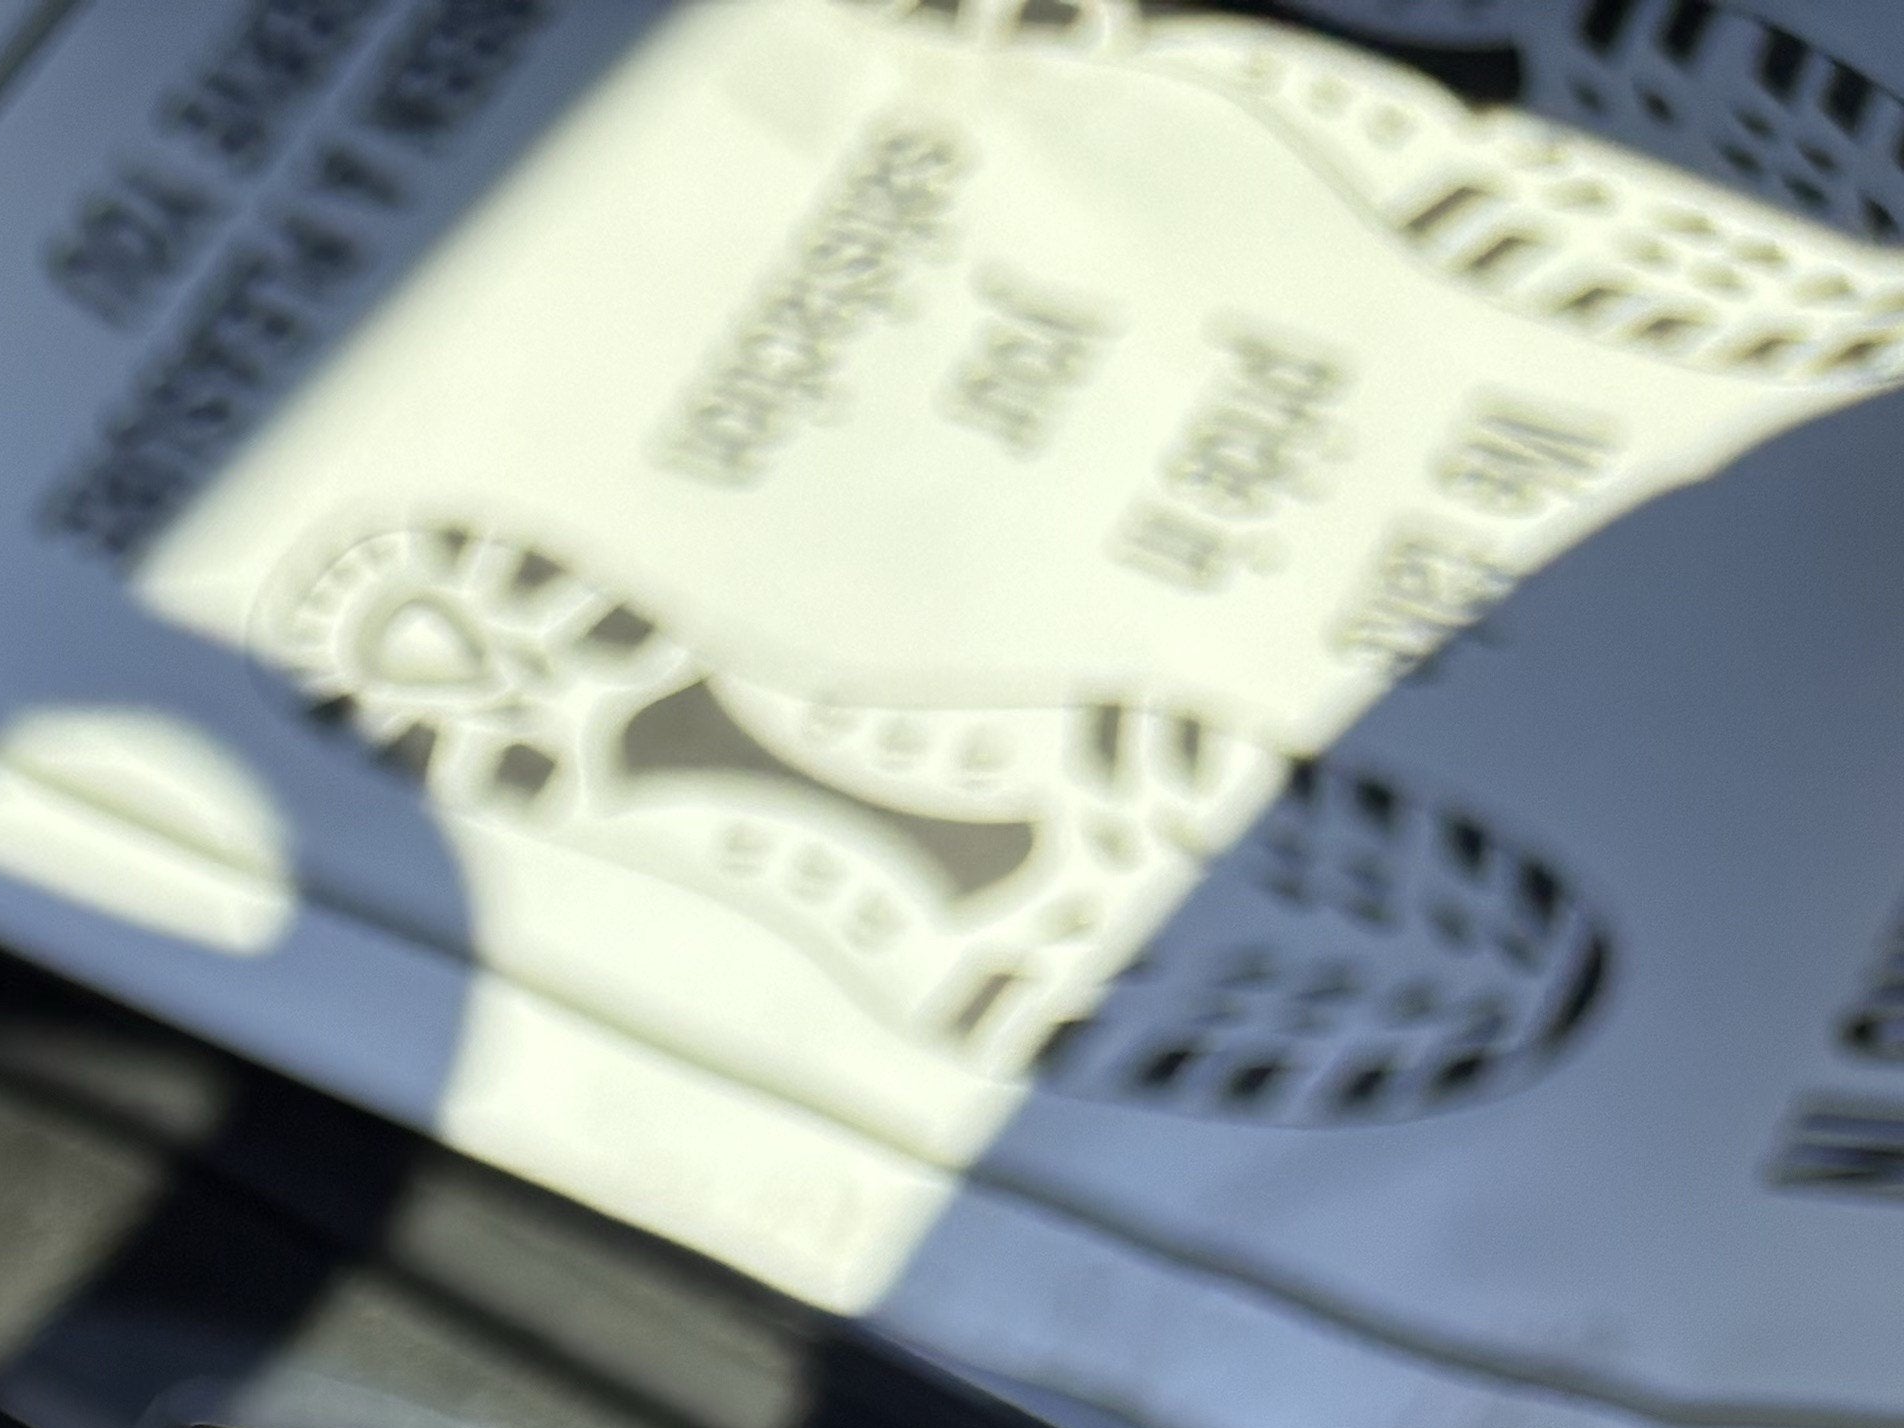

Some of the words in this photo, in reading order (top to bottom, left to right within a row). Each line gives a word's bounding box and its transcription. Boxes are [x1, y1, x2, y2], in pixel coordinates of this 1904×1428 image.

[45, 148, 214, 328] YOU
[937, 256, 1127, 460] your
[1156, 310, 1357, 520] pride
[1430, 388, 1620, 518] We
[1107, 500, 1286, 592] in
[1324, 515, 1517, 682] take
